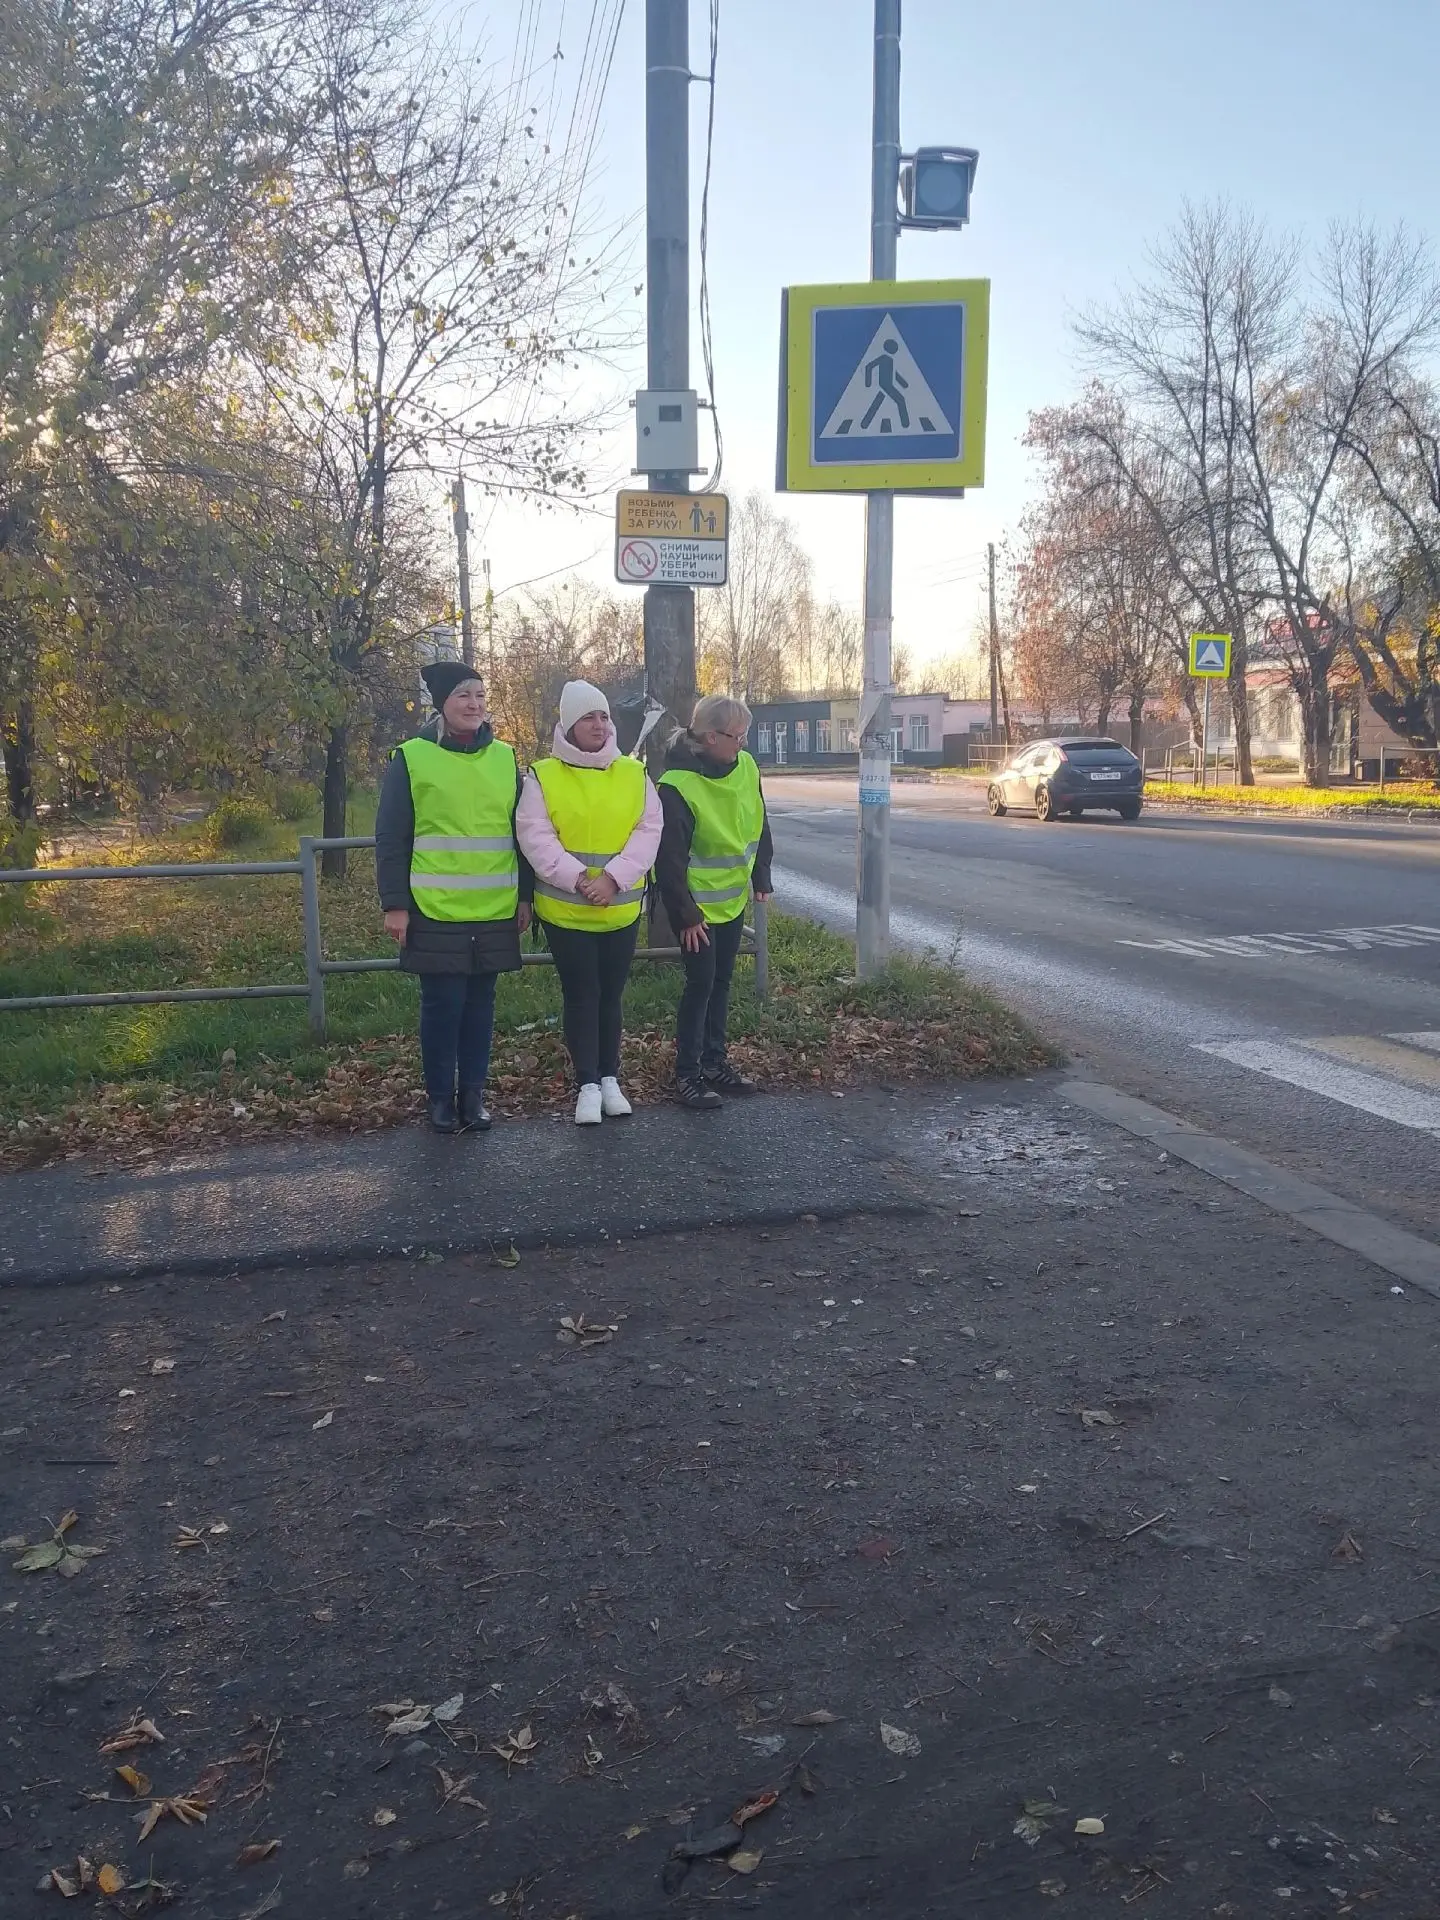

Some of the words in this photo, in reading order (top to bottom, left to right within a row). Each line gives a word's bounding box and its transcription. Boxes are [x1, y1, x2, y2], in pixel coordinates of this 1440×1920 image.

[628, 499, 674, 508] ВОЗЬМИ
[628, 519, 644, 528] ЗА
[647, 520, 682, 530] РУКУ!
[660, 543, 699, 552] СНИМИ
[660, 552, 723, 561] НАУШНИКИ
[660, 561, 697, 569] УБЕРИ
[661, 570, 718, 579] ТЕЛЕФОН!
